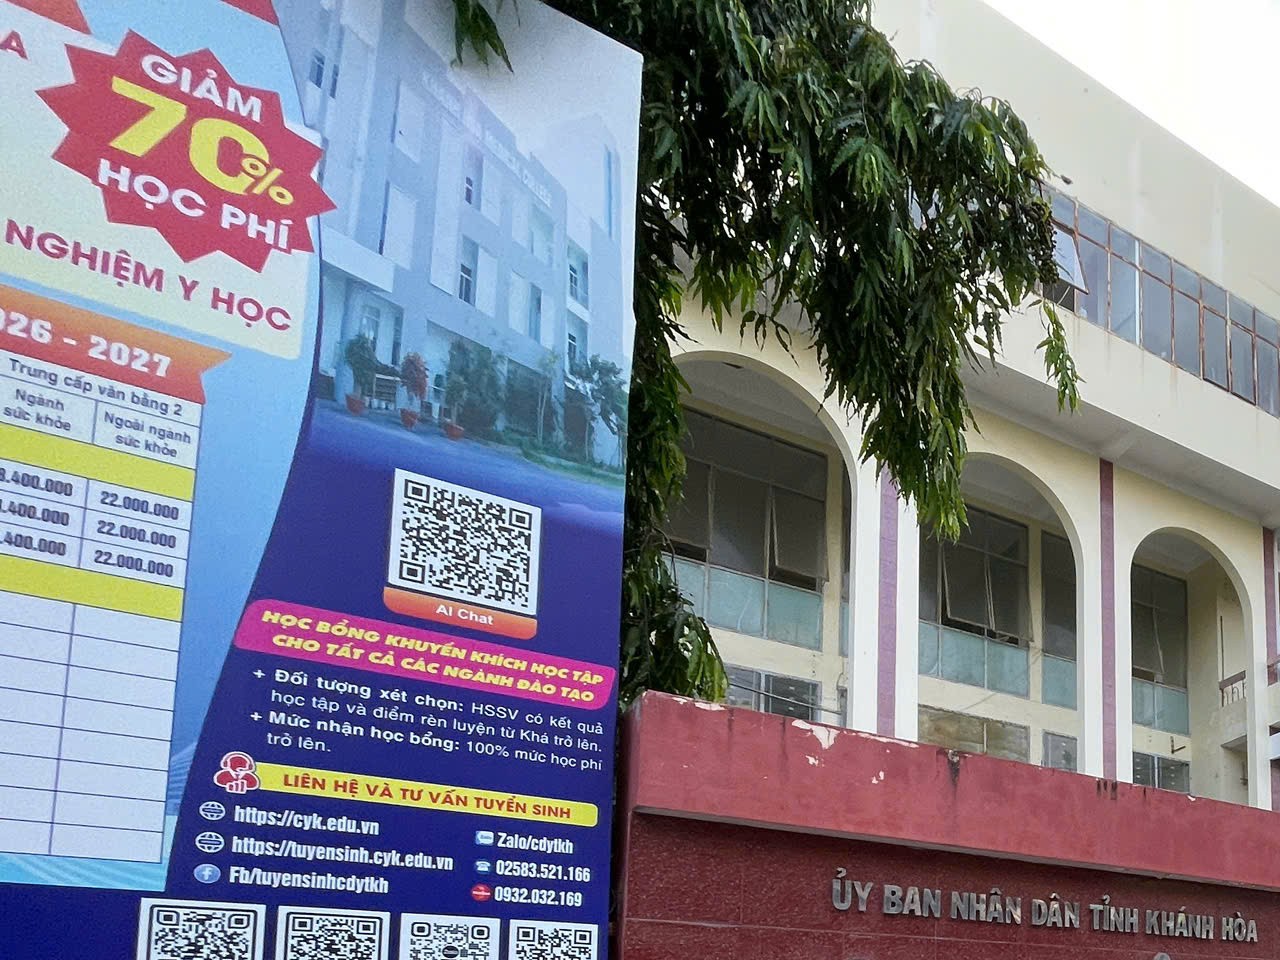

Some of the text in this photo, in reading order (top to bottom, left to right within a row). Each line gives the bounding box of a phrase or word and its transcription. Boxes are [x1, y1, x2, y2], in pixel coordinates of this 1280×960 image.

[141, 54, 262, 123] GIẢM
[109, 75, 294, 206] 70%
[98, 158, 293, 249] HỌC PHÍ
[5, 218, 291, 331] NGHIỆM Y HỌC
[88, 334, 171, 377] 2027
[9, 358, 59, 385] Trung
[64, 373, 92, 393] cấp
[174, 404, 182, 416] 2
[15, 389, 64, 411] Ngành
[3, 405, 71, 431] sức khỏe
[104, 411, 191, 444] Ngoài ngành
[116, 434, 177, 458] sức khỏe
[0, 499, 70, 526] .400.000
[101, 491, 179, 520] 22.000.000
[97, 520, 176, 548] 22.000.000
[94, 550, 173, 577] 22.000.000
[436, 604, 494, 625] AI Chat
[262, 610, 604, 686] HỌC BỔNG KHUYẾN KHÍCH HỌC TẬP
[272, 634, 595, 702] CHO TẤT CẢ CÁC NGÀNH ĐÀO TẠO
[253, 669, 603, 736] + Đối tượng xét chọn: HSSV có kết quả
[271, 689, 602, 752] học tập và điểm rèn luyện từ Khá trở lên.
[250, 711, 602, 771] + Mức nhận học bổng: 100% mức học phí
[267, 732, 331, 752] trở lên.
[283, 772, 571, 819] LIÊN HỆ VÀ TƯ VẤN TUYỂN SINH
[234, 805, 380, 836] https://cyk.edu.vn
[231, 836, 454, 871] https://tuyensinh.cyk.edu.vn
[497, 832, 574, 855] Zalo/cdytkh
[229, 865, 389, 894] Fb/tuyensinhcdytkh
[496, 860, 590, 882] 02583.521.166
[494, 886, 582, 907] 0932.032.169
[831, 867, 1258, 943] ỦY BAN NHÂN DÂN TỈNH KHÁNH HÒA
